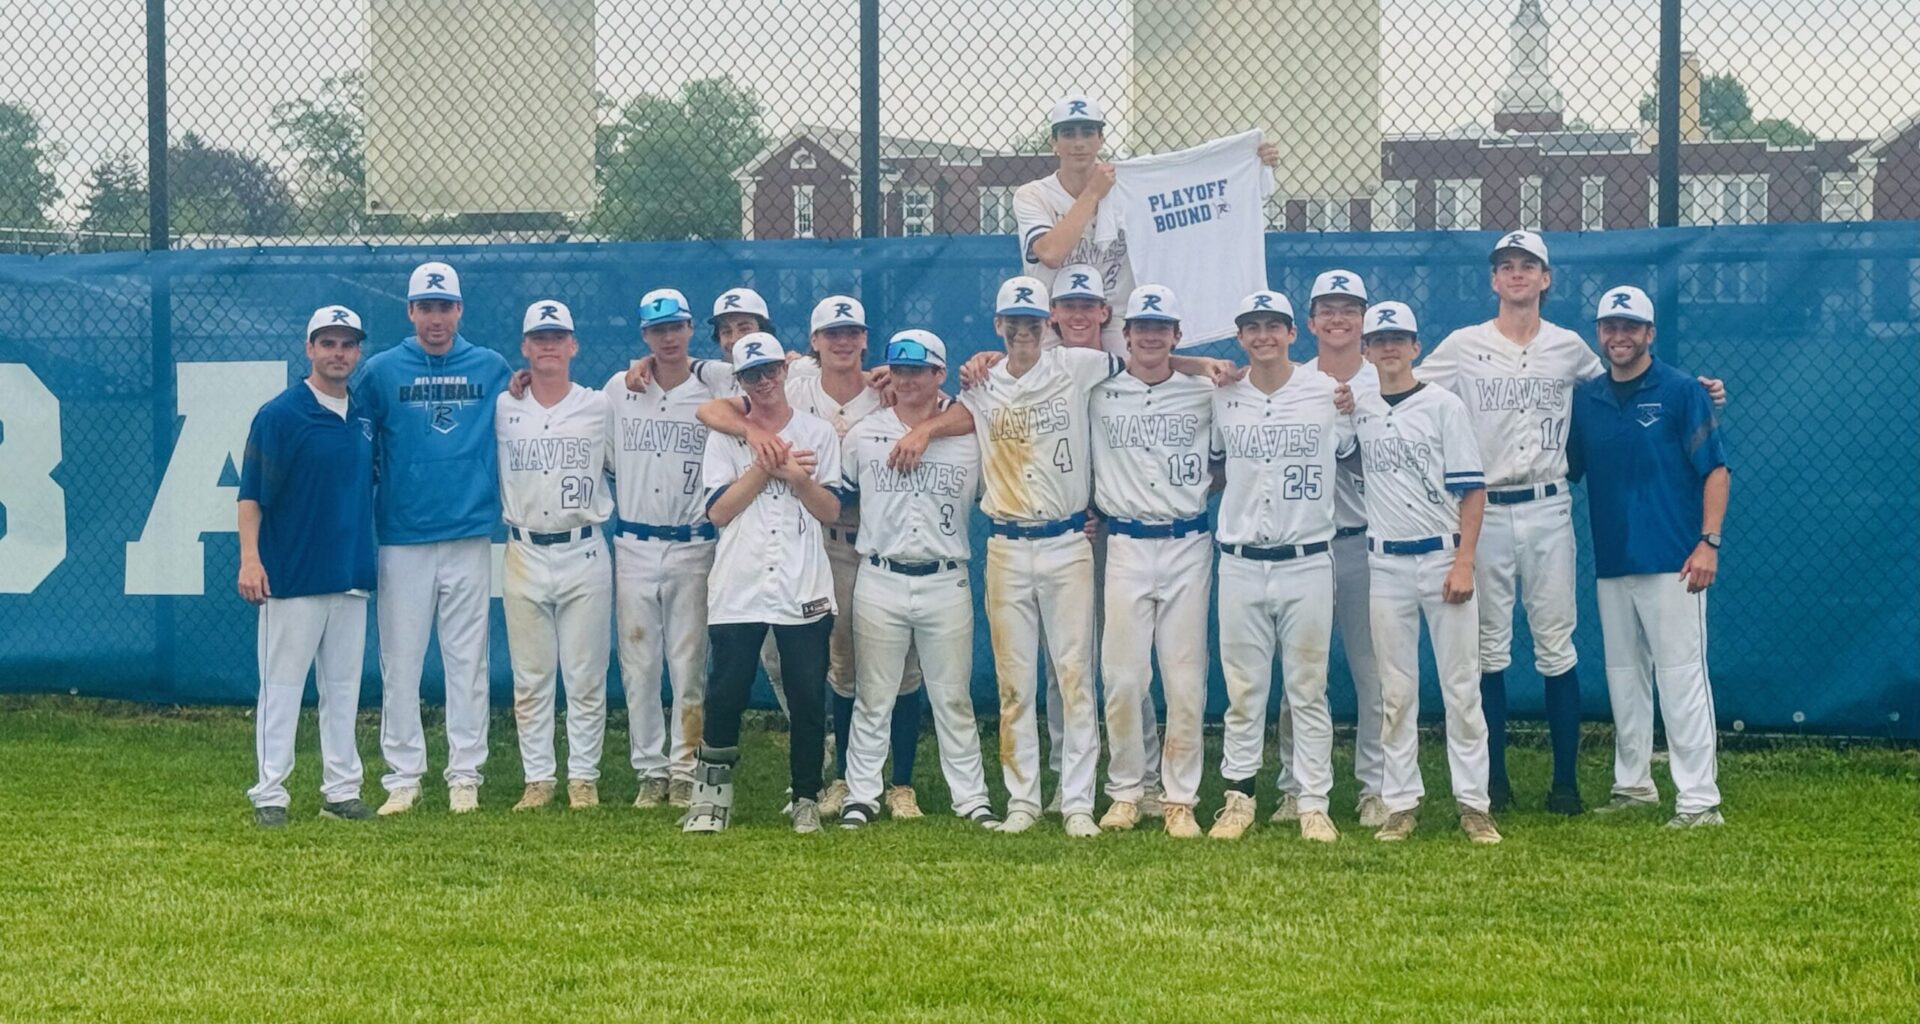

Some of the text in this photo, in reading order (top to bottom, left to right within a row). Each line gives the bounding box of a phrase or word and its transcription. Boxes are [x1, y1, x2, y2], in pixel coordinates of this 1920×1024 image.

[1148, 178, 1228, 212] PLAYOFF
[1153, 204, 1212, 233] BOUND
[400, 384, 485, 402] BASEBALL
[1475, 377, 1565, 412] WAVES
[982, 396, 1070, 442] WAVES
[1102, 414, 1199, 449] WAVES
[621, 418, 708, 455] WAVES
[1223, 424, 1321, 459] WAVES
[506, 437, 592, 471] WAVES
[1053, 438, 1073, 473] 4
[1168, 452, 1202, 486] 13
[561, 476, 594, 509] 20
[683, 461, 700, 494] 7
[870, 459, 968, 499] WAVES
[1283, 464, 1322, 500] 25
[939, 503, 957, 536] 3
